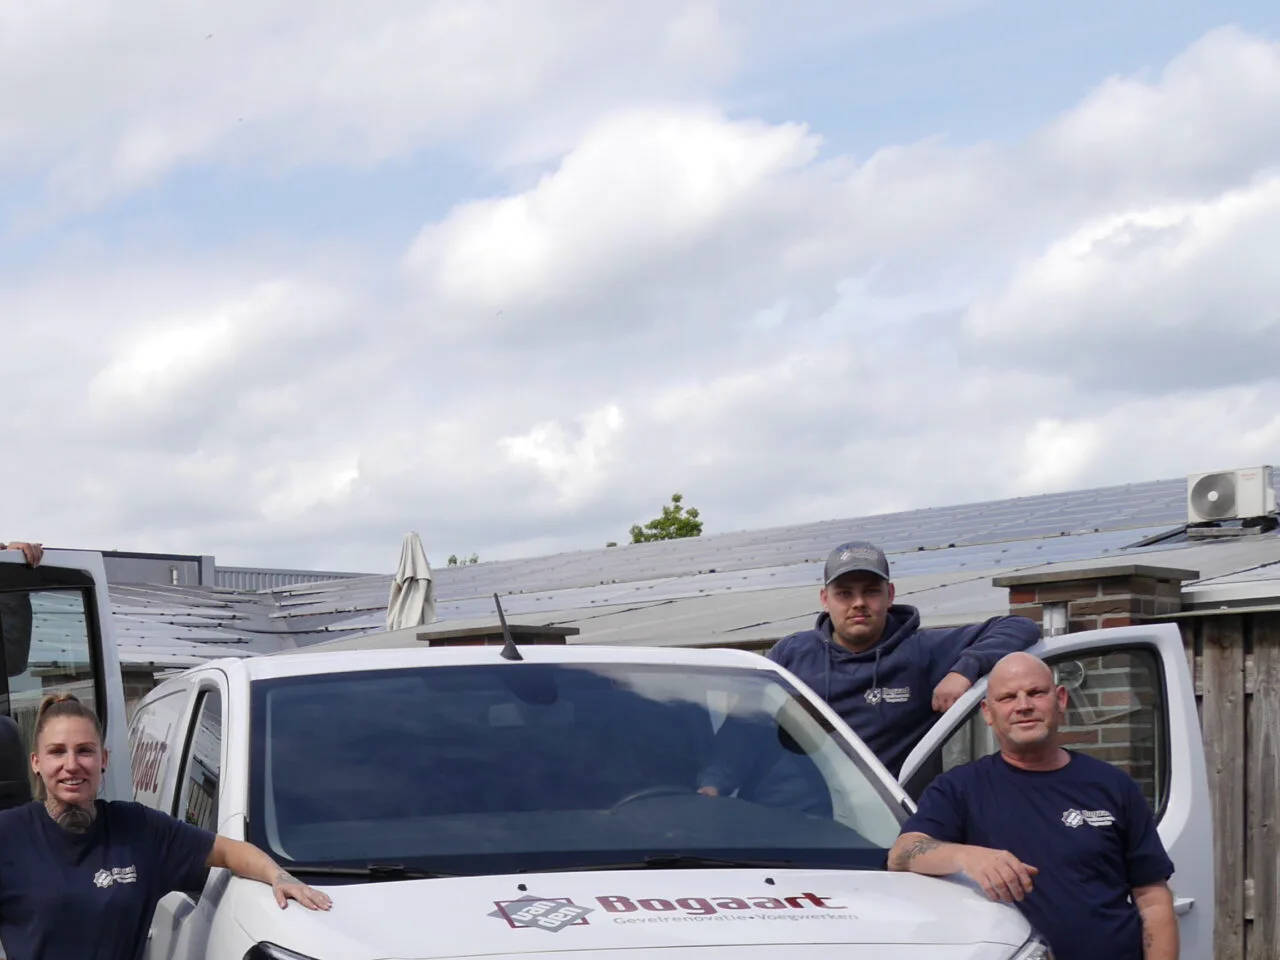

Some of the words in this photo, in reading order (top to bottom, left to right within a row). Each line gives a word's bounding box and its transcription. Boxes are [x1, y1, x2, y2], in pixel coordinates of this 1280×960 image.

[511, 901, 557, 921] van
[595, 892, 848, 915] Bogaart
[536, 906, 582, 928] den
[613, 914, 748, 924] Gevelrenovatie
[755, 913, 859, 921] Voegwerken
